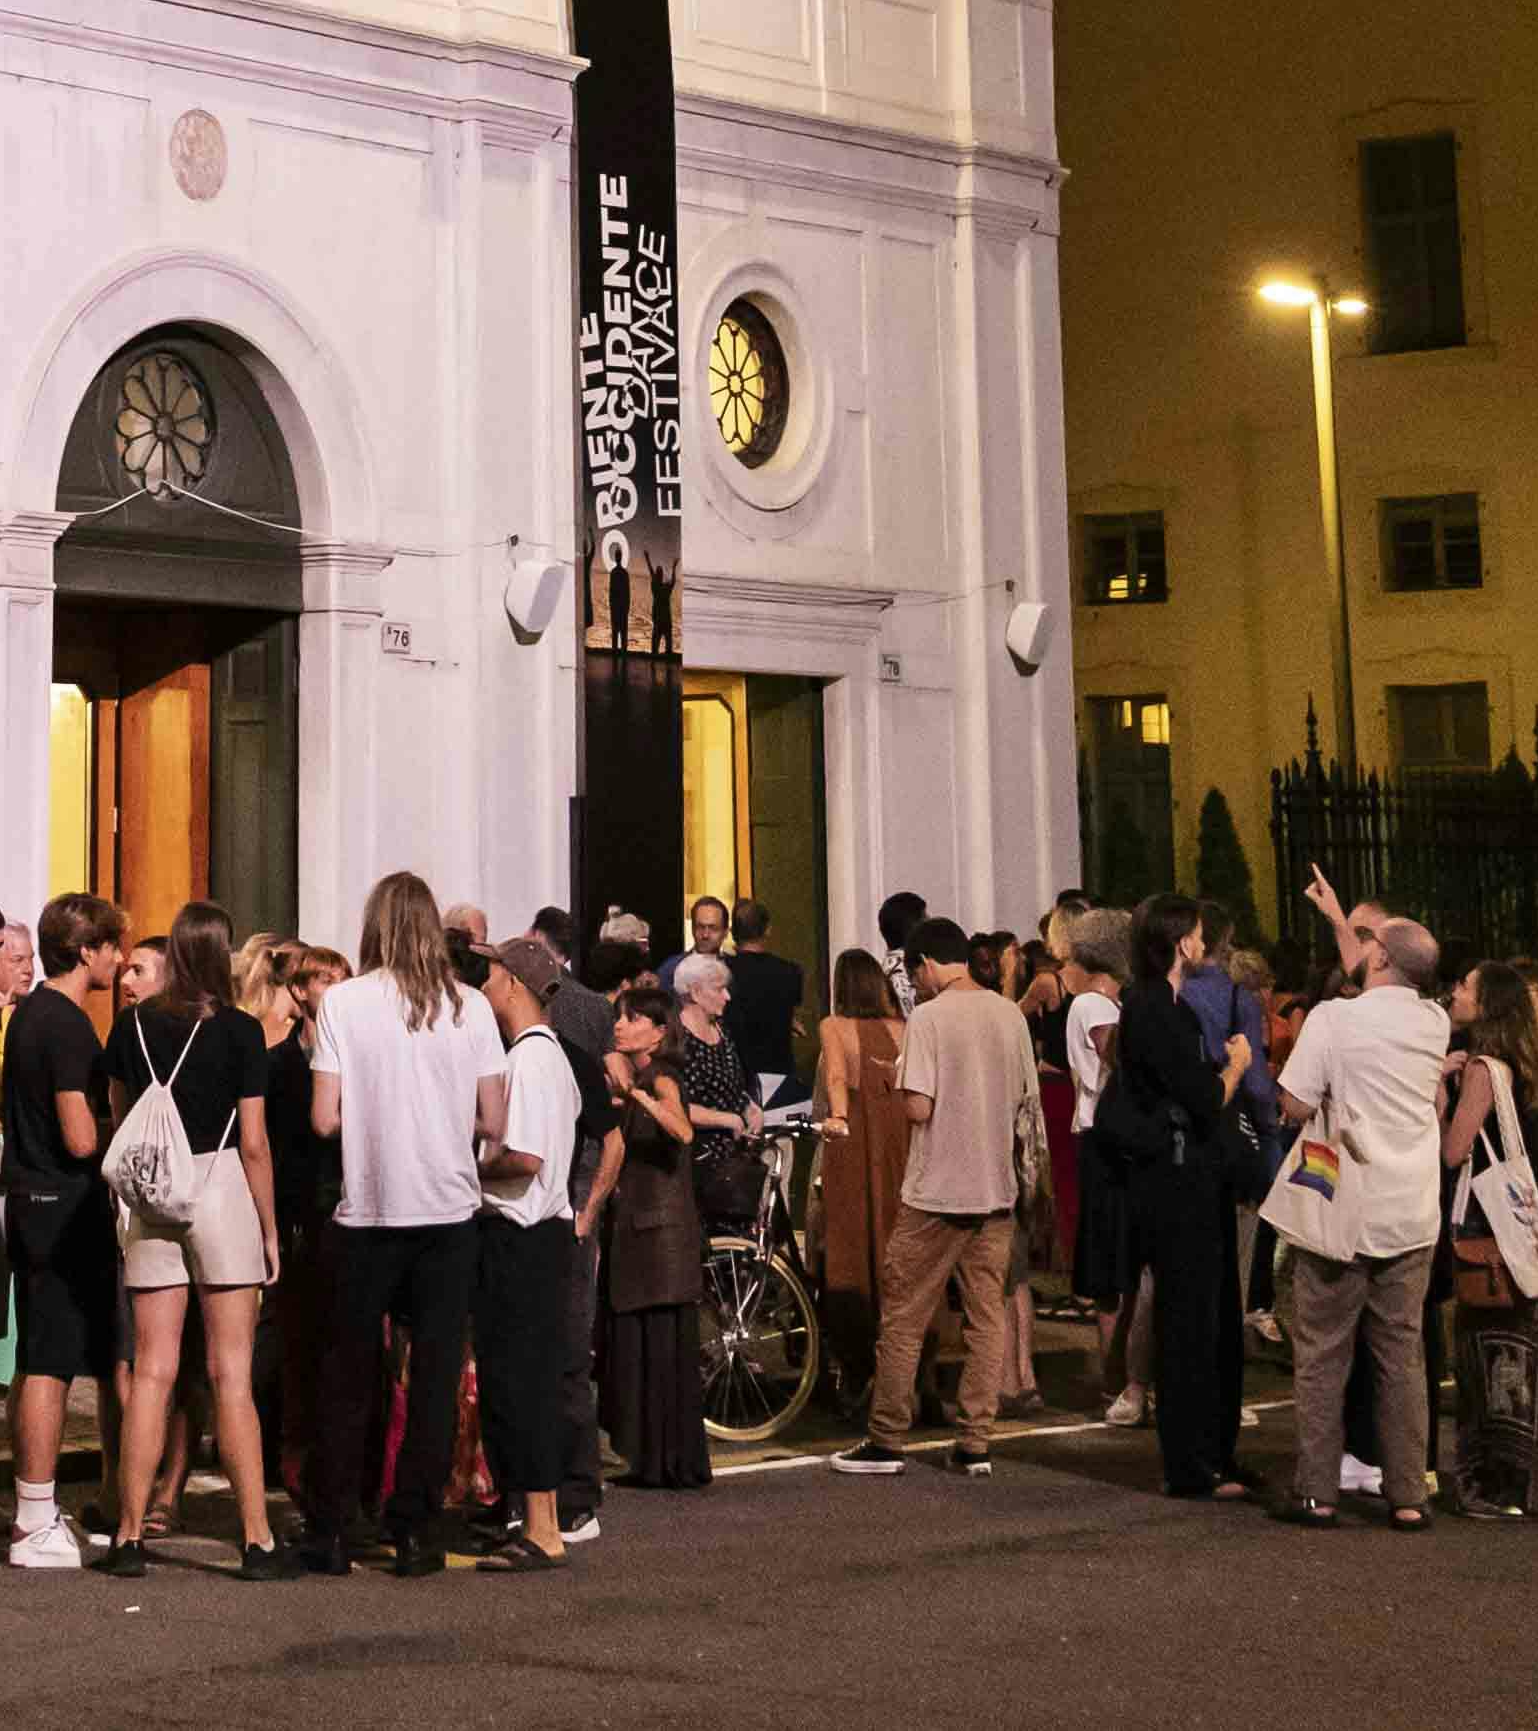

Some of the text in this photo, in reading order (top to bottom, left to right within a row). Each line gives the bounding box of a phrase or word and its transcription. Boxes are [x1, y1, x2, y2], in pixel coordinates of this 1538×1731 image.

[579, 312, 631, 572] ORIENTE
[599, 173, 639, 525] OCCIDENTE
[622, 224, 666, 419] DANCE
[646, 267, 682, 517] FESTIVAL
[392, 629, 410, 647] 76
